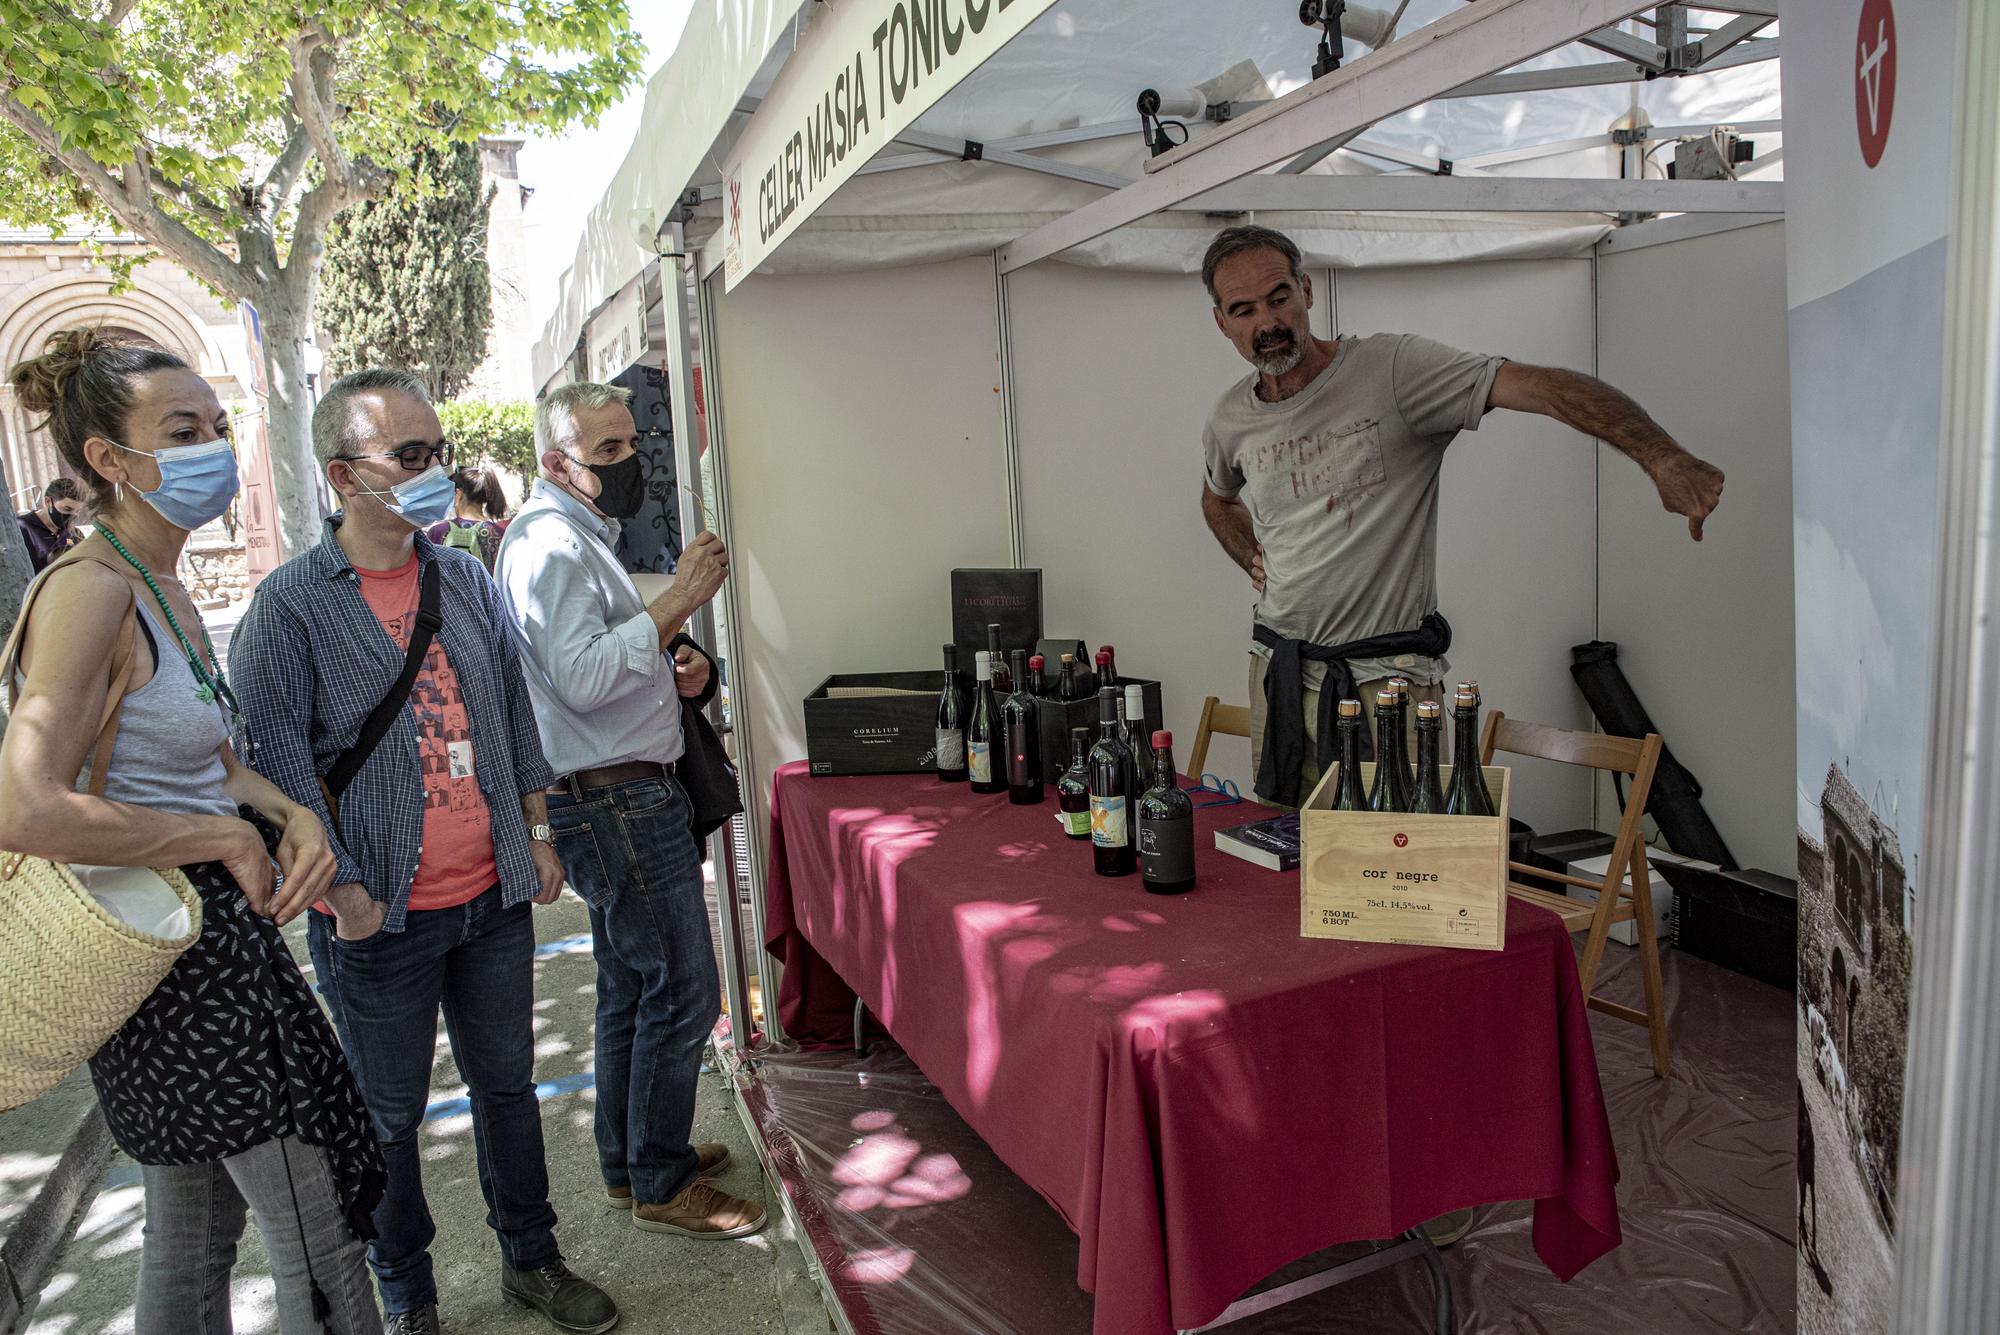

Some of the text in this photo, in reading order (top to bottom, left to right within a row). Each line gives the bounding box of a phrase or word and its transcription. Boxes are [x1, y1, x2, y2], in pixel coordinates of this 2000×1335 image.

[758, 129, 804, 246] CELLER
[807, 50, 870, 193] MASIA
[853, 727, 899, 735] CORELIUM
[1362, 868, 1439, 884] cor negre
[1392, 884, 1408, 892] 2010
[1322, 909, 1341, 919] 750
[1322, 917, 1350, 926] 6 BOT
